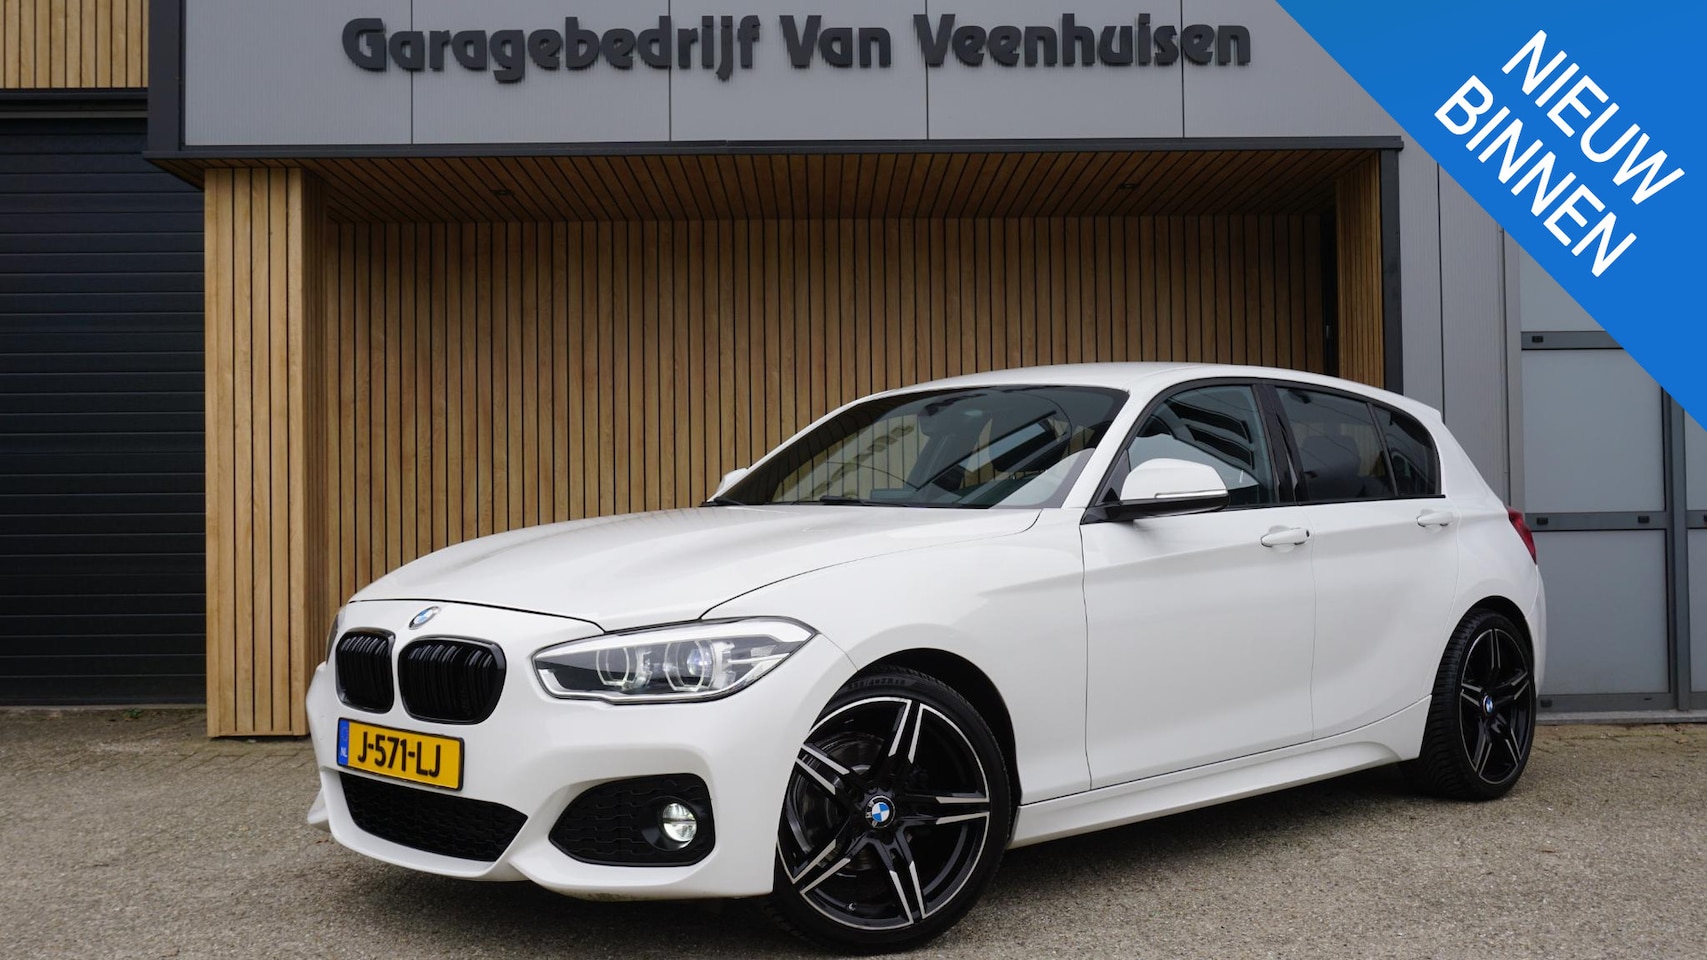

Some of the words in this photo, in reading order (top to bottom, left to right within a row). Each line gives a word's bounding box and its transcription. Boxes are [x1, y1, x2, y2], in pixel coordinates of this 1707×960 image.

[341, 14, 761, 84] Garagebedrijf
[778, 14, 892, 69] Van
[913, 13, 1251, 68] Veenhuisen
[358, 731, 441, 777] J-571-LJ
